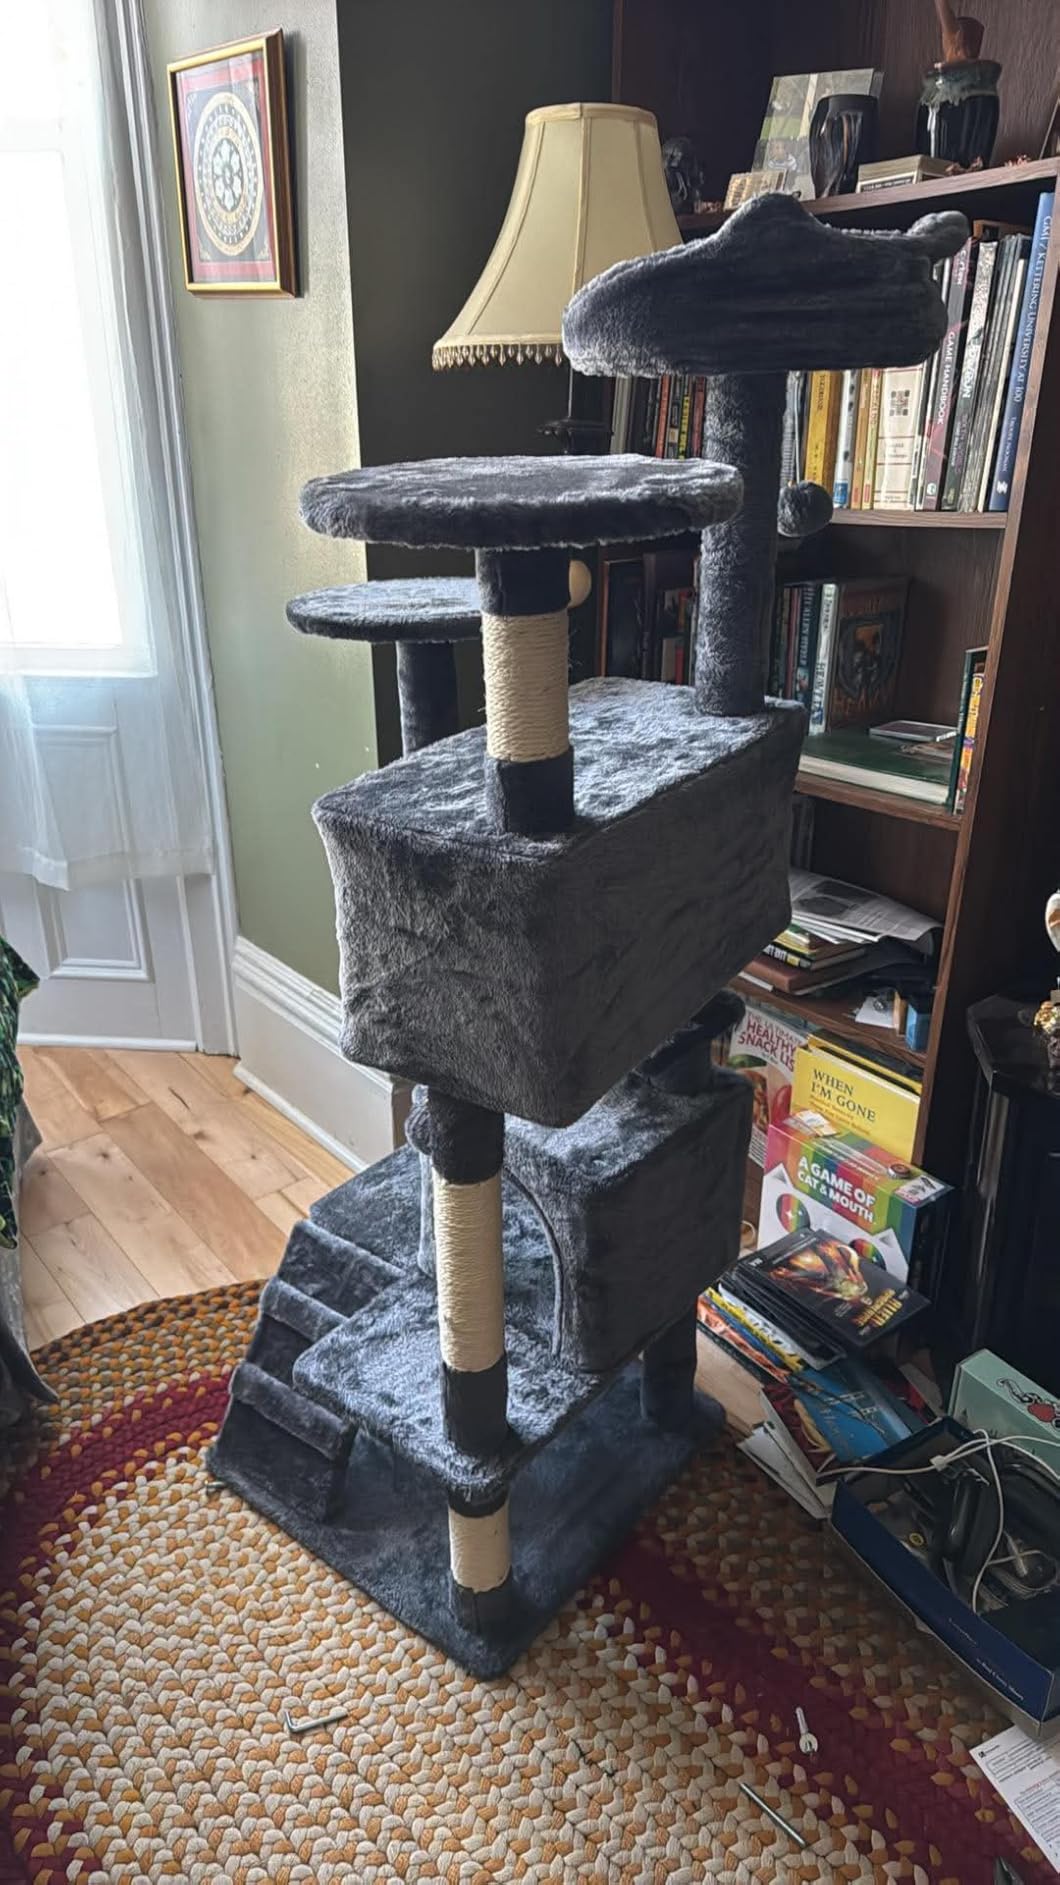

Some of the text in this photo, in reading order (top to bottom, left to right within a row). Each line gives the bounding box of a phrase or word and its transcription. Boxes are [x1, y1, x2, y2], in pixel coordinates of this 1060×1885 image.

[1041, 216, 1052, 240] GMI
[1029, 252, 1047, 309] KETTERING
[1018, 311, 1037, 369] UNIVERSITY
[937, 331, 956, 425] GAME HANDBOOK
[1013, 386, 1025, 402] 100
[738, 1031, 777, 1058] SNACK
[781, 1050, 796, 1072] LIS
[747, 1019, 797, 1057] HEALTHY
[811, 1081, 876, 1123] I'M GONE
[813, 1069, 854, 1096] WHEN
[798, 1171, 874, 1223] CAT & MOUTH
[799, 1156, 810, 1170] A
[811, 1162, 853, 1196] GAME
[853, 1187, 876, 1207] OF
